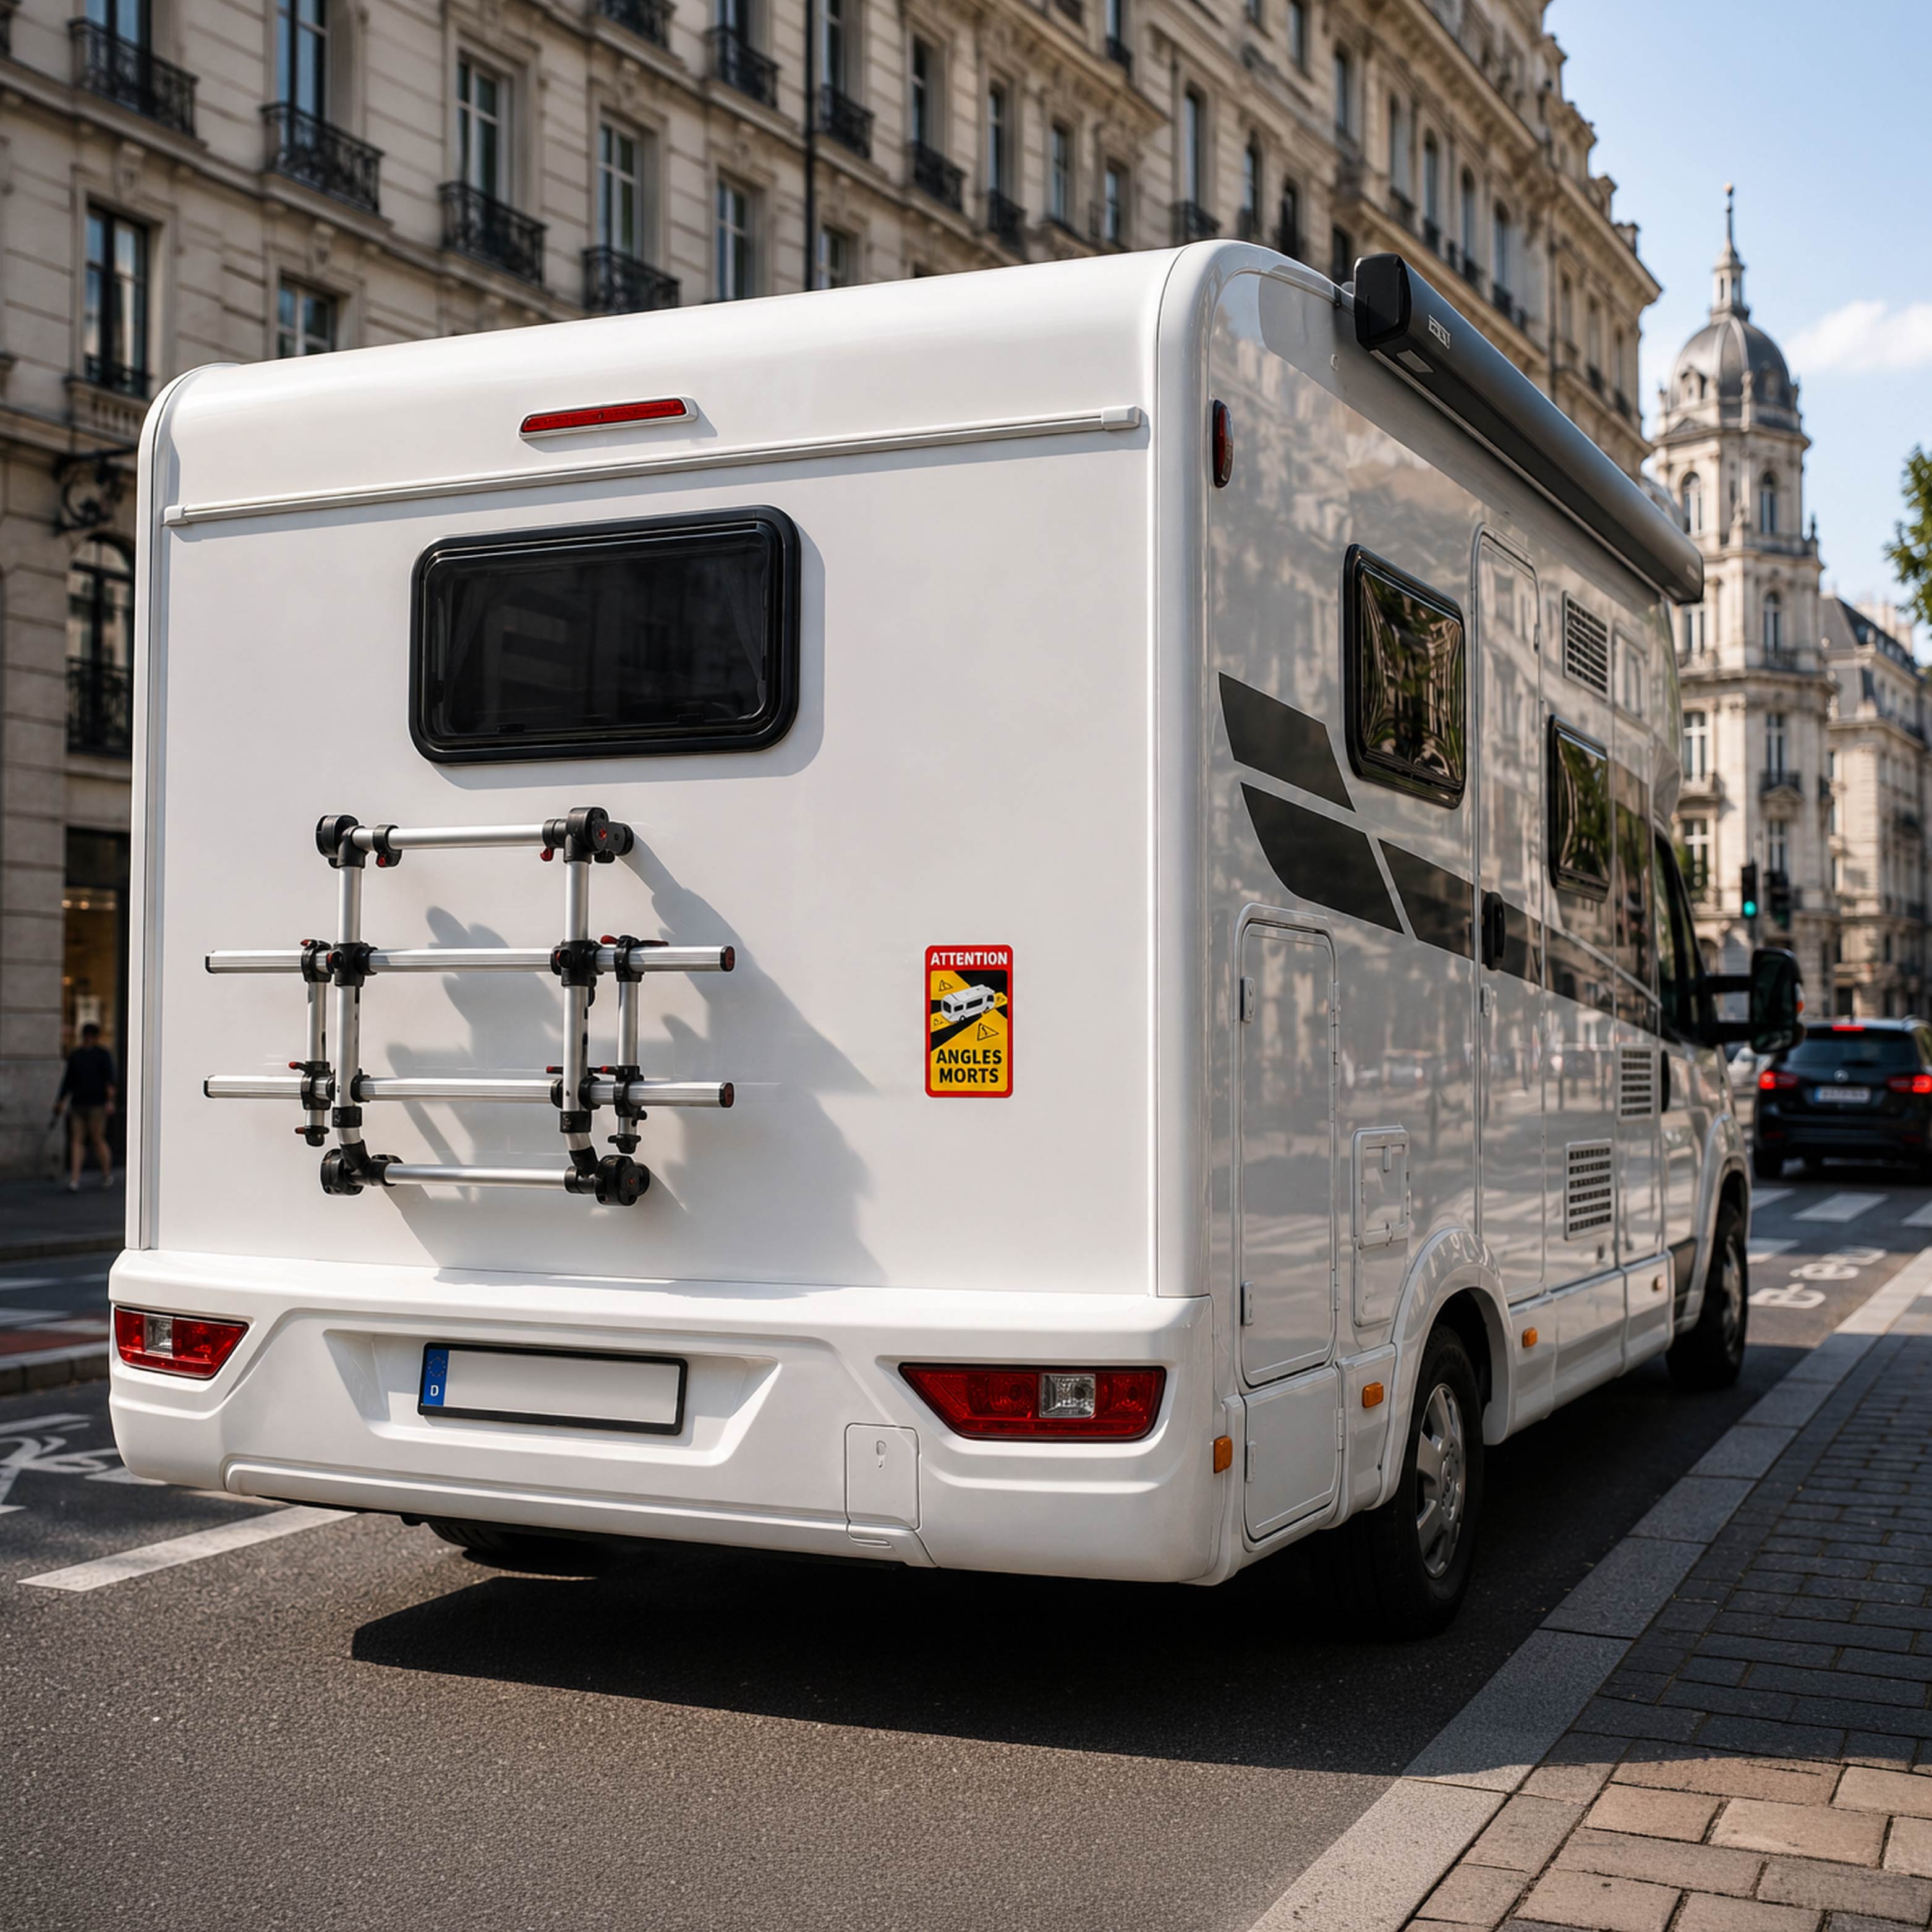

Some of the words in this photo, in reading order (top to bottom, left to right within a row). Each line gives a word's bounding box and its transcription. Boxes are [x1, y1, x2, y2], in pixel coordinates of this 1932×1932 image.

[930, 952, 1007, 966] ATTENTION
[936, 1049, 1002, 1064] ANGLES
[939, 1068, 998, 1083] MORTS
[430, 1385, 439, 1397] D
